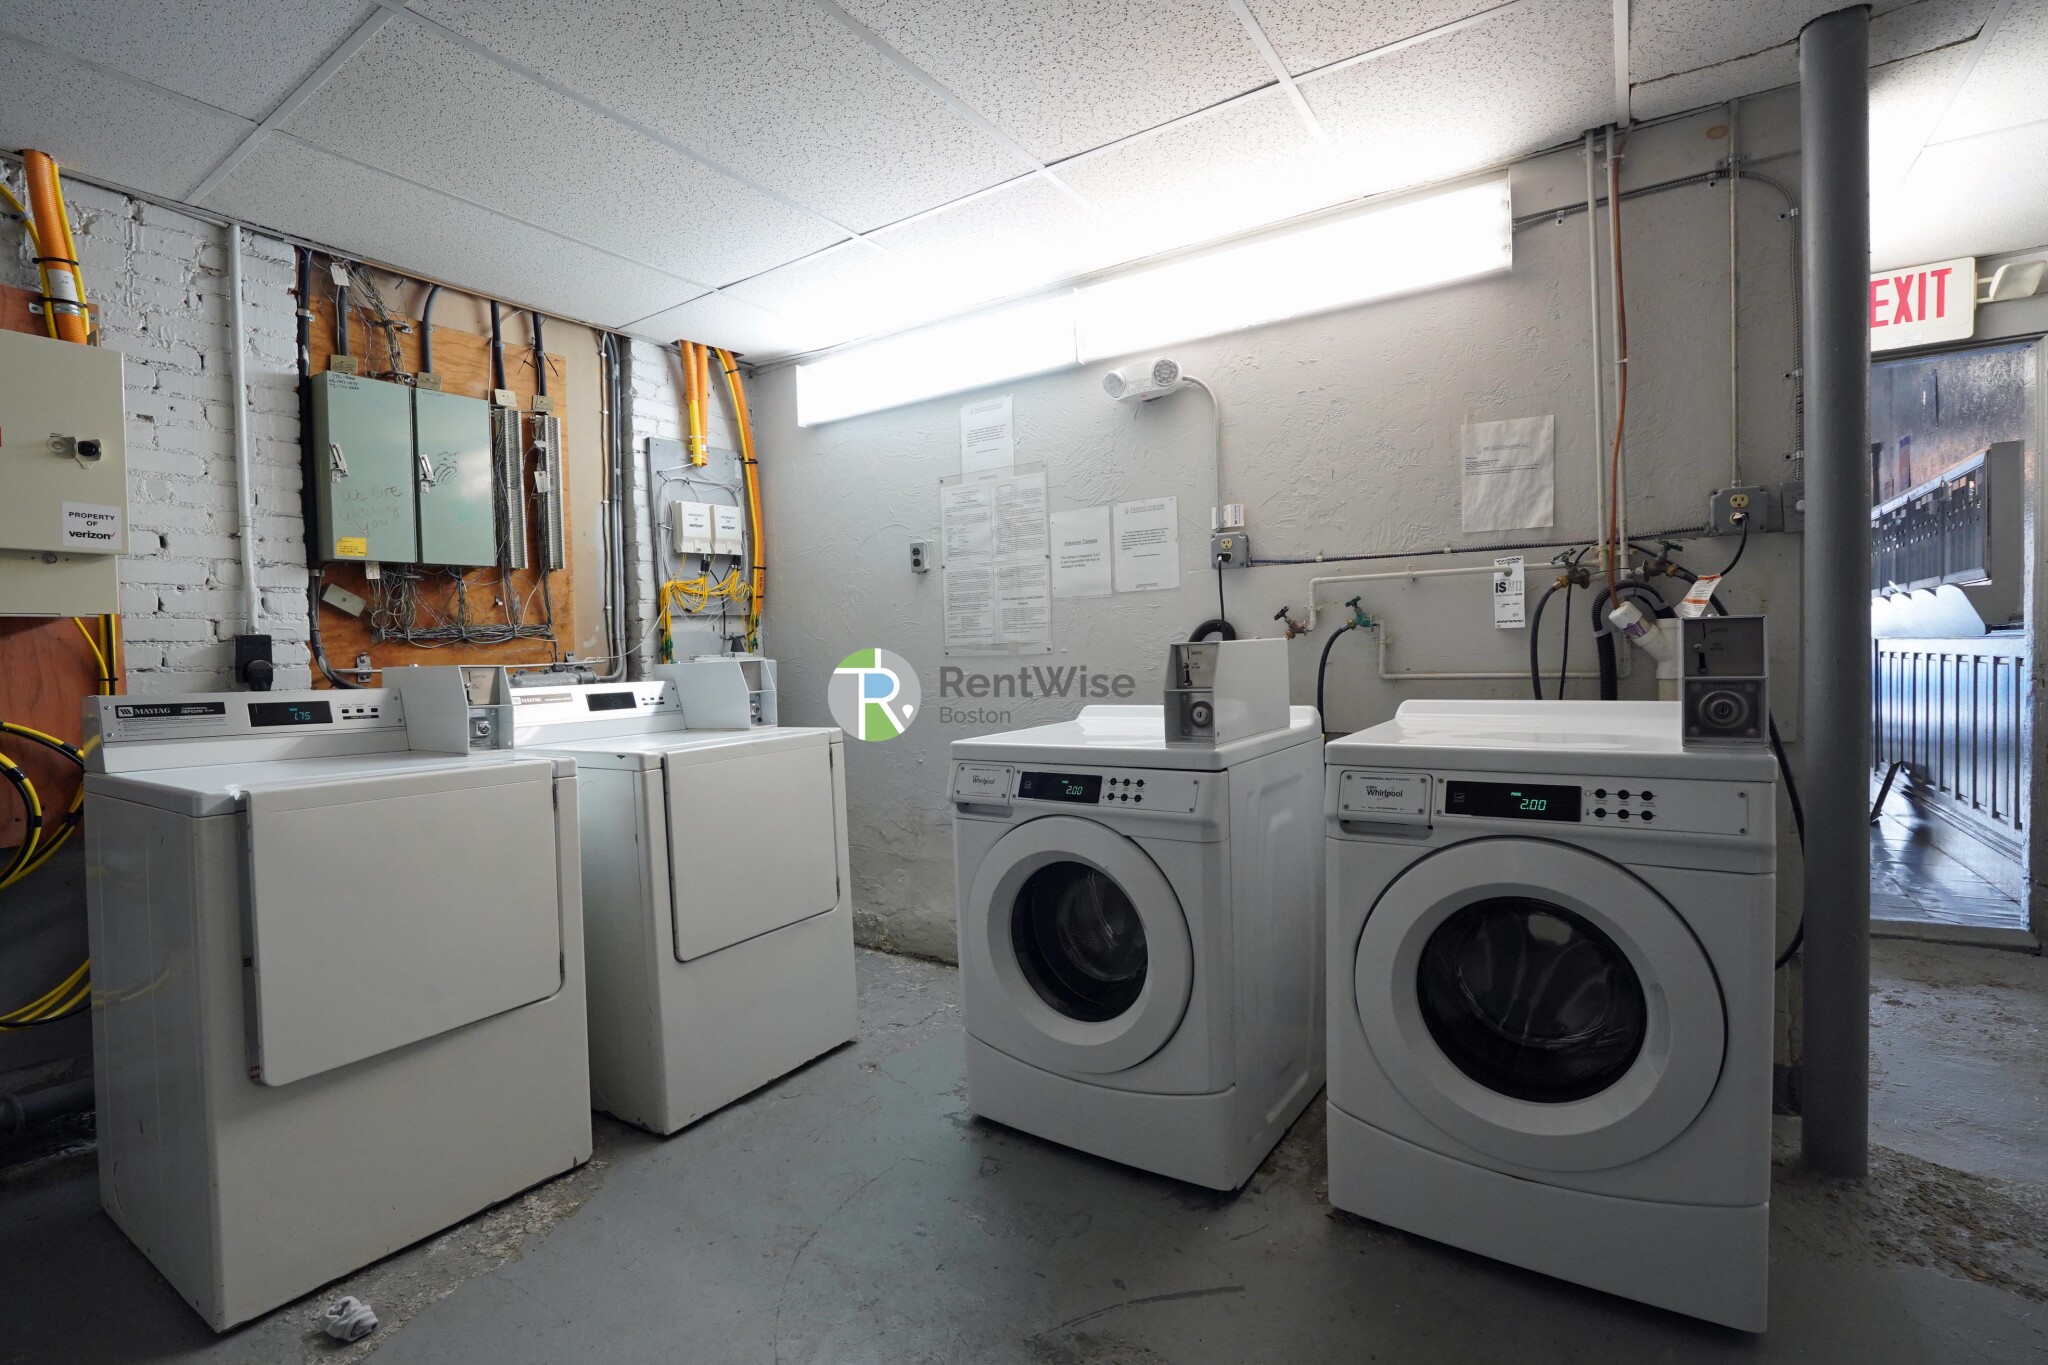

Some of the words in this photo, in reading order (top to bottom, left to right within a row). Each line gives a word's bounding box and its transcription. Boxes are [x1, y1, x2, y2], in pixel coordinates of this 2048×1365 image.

[1870, 267, 1952, 328] EXIT
[68, 511, 115, 521] PROPERTY
[68, 530, 112, 540] verizon
[135, 707, 171, 715] MAYTAG
[1366, 788, 1403, 798] Whirlpool
[1519, 798, 1547, 811] 2.00
